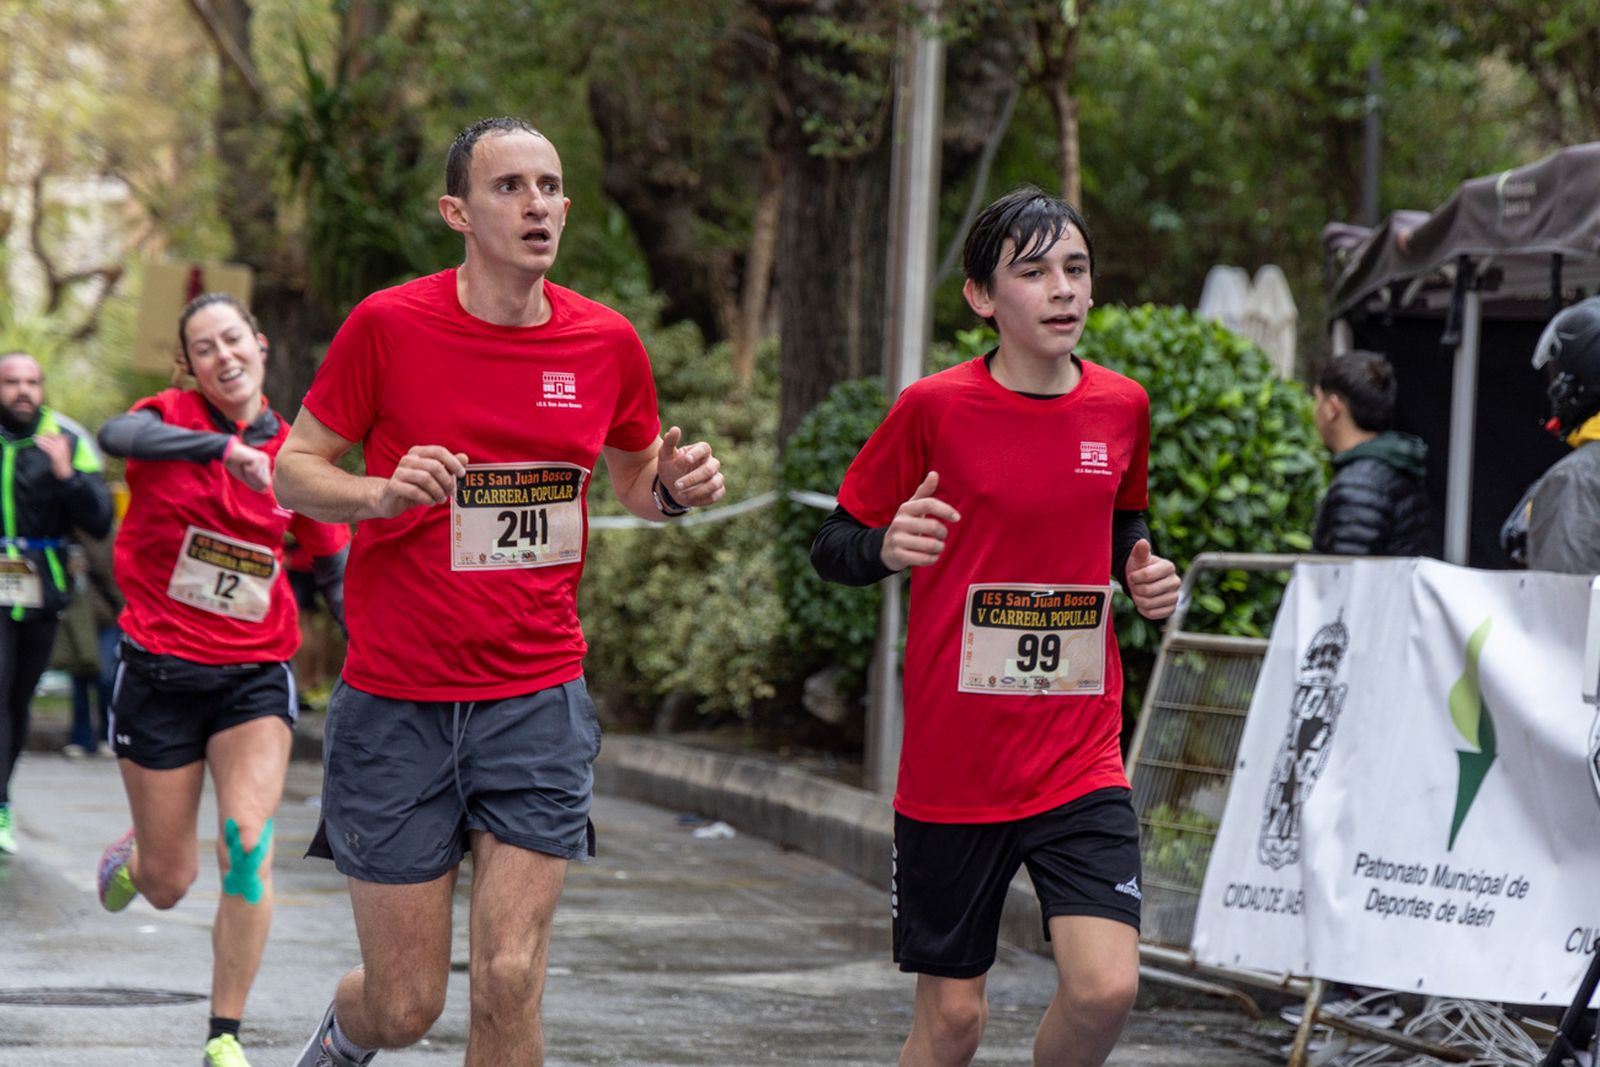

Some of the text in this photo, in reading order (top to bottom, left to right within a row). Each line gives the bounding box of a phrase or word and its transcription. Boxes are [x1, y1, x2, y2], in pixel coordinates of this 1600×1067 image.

[465, 473, 484, 487] IES
[488, 473, 511, 486] San
[541, 470, 572, 483] Bosco
[462, 485, 573, 504] V CARRERA POPULAR
[497, 508, 548, 548] 241
[214, 571, 239, 600] 12
[982, 592, 1097, 609] IES San Juan Bosco
[977, 608, 1098, 627] V CARRERA POPULAR
[1016, 633, 1061, 673] 99
[1353, 853, 1530, 900] Patronato Municipal de
[1365, 888, 1496, 928] Deportes de Jaén
